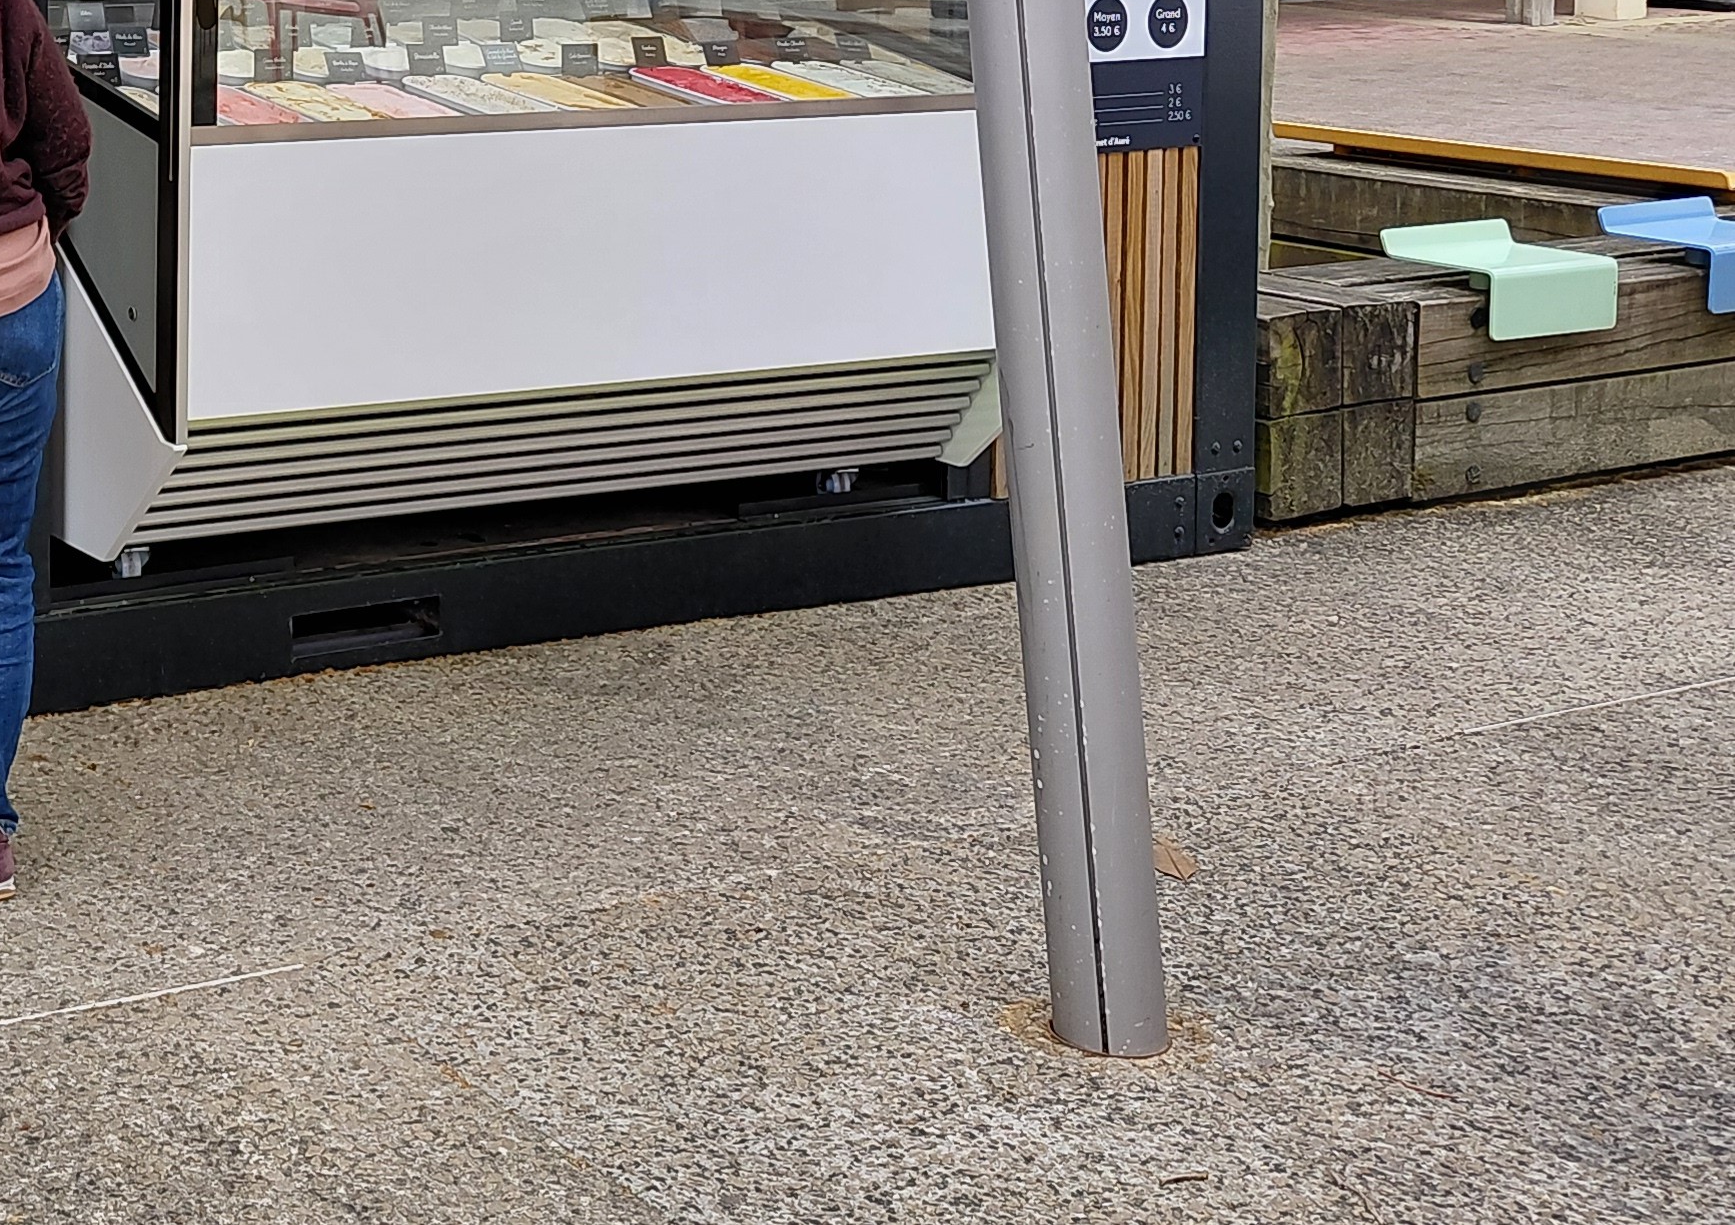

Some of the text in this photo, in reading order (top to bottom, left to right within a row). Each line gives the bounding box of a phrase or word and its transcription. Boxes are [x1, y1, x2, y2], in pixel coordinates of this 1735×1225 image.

[1093, 11, 1121, 23] Moyen
[1155, 8, 1181, 19] Grand
[1093, 26, 1120, 36] 3.50 €
[1161, 23, 1176, 33] 4 €
[1168, 83, 1182, 94] 3 €
[1168, 97, 1182, 107] 2 €
[1186, 110, 1192, 119] €
